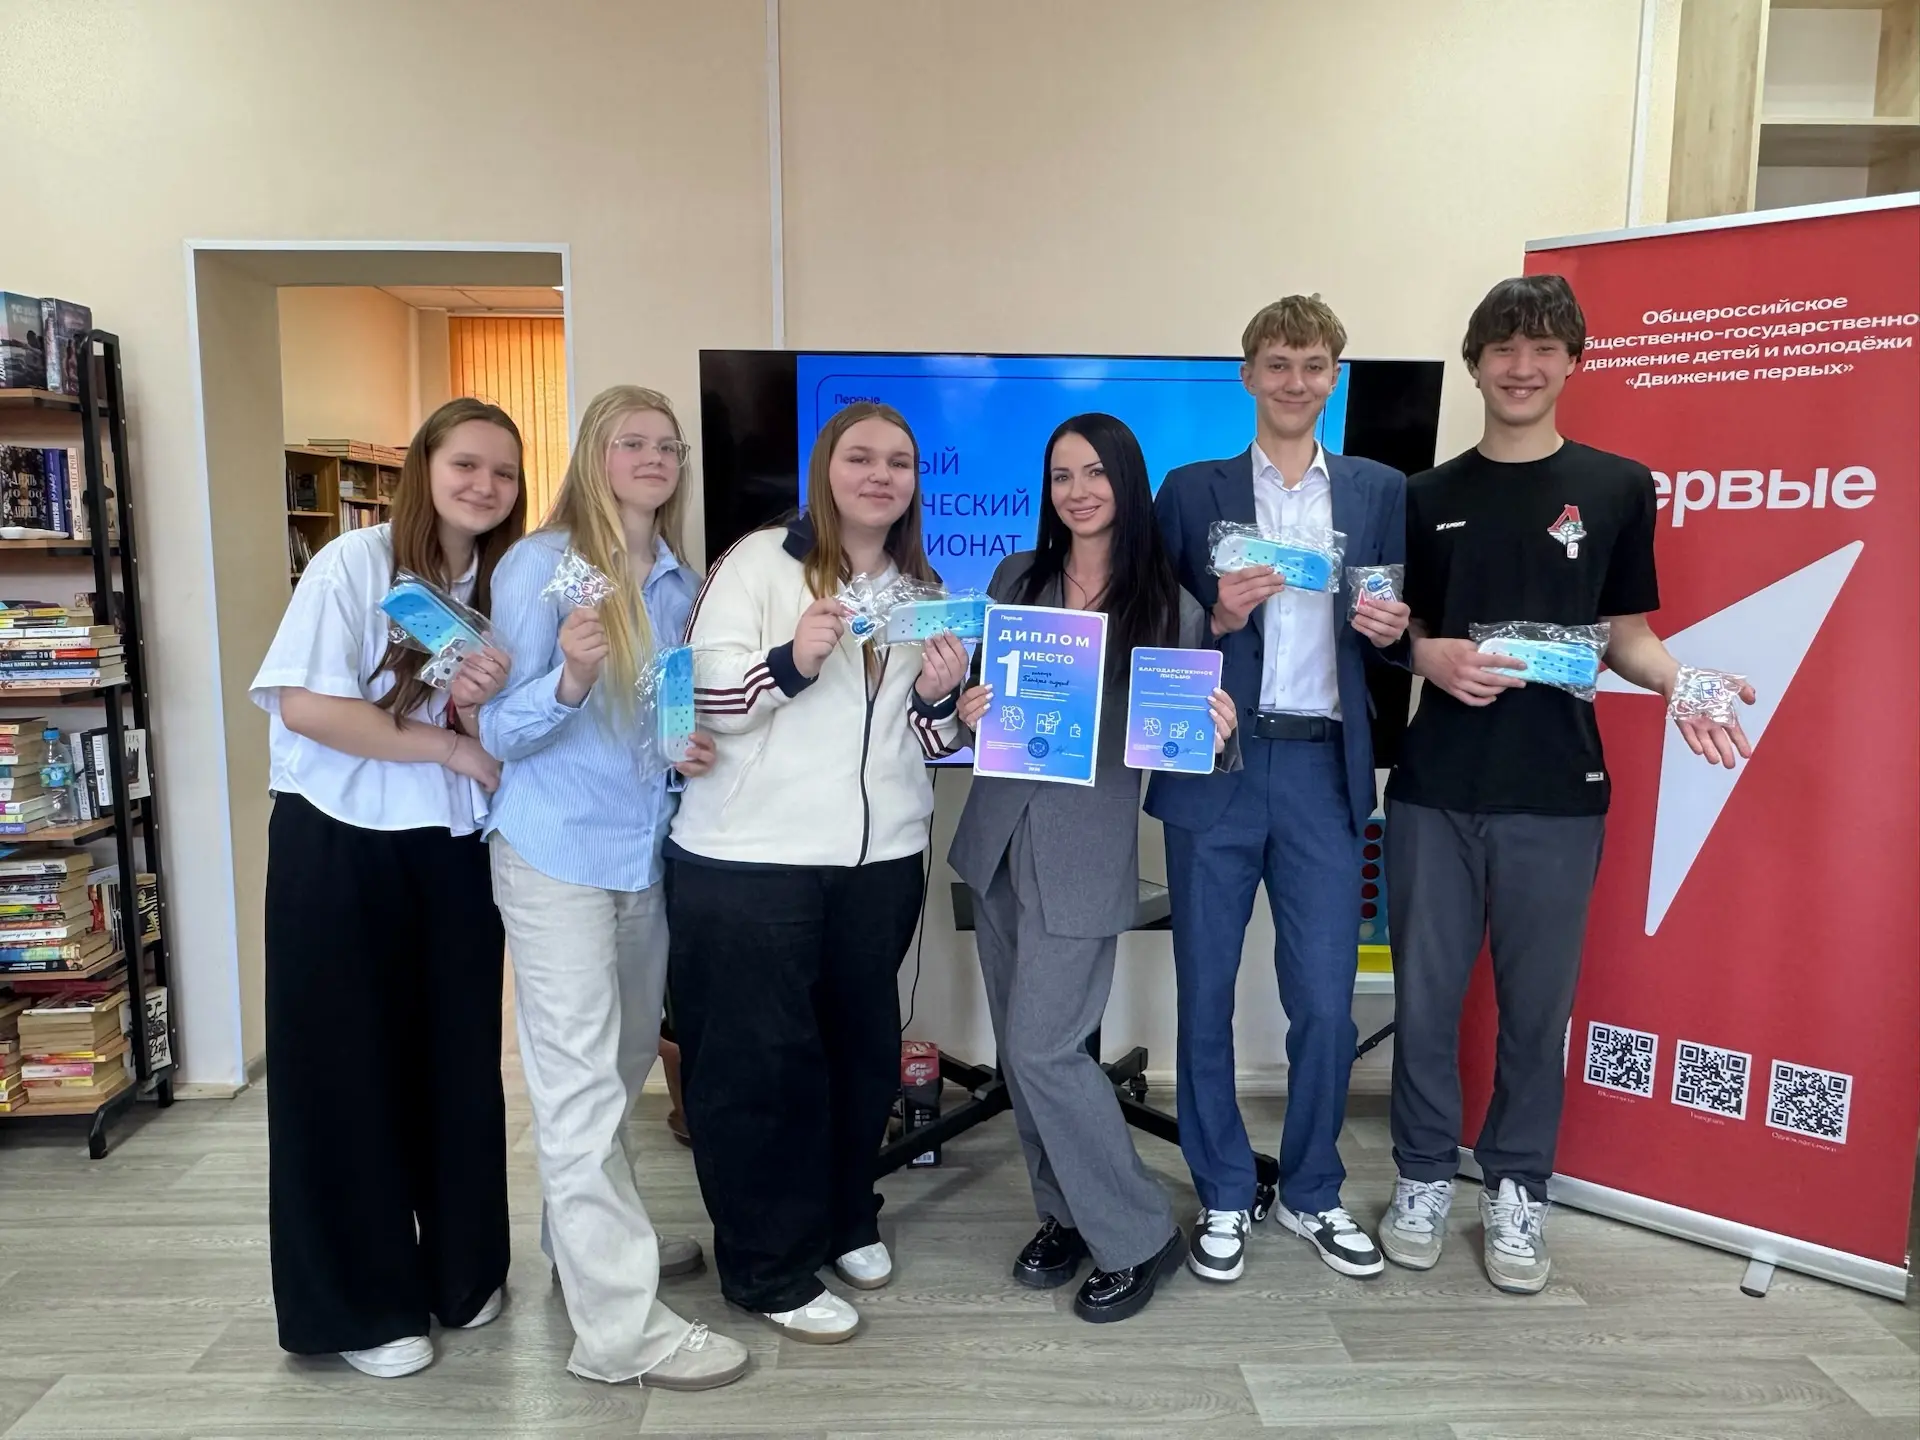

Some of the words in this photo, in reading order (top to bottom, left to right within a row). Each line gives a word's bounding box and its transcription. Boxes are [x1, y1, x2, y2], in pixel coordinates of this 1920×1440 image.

[1642, 296, 1848, 325] Общероссийское
[1584, 313, 1920, 350] бщественно-государственно
[1582, 351, 1690, 372] движение
[1692, 344, 1760, 364] детей
[1764, 345, 1779, 358] и
[1783, 335, 1912, 358] молодёжи
[1625, 367, 1749, 389] «Движение
[1753, 362, 1854, 382] первых»
[918, 446, 959, 475] ЫЙ
[921, 488, 1030, 516] ЧЕСКИЙ
[1650, 464, 1877, 528] ервые
[926, 533, 1022, 556] ИОНАТ
[998, 629, 1090, 648] ДИПЛОМ
[1023, 651, 1075, 665] МЕСТО
[997, 650, 1020, 697] 1
